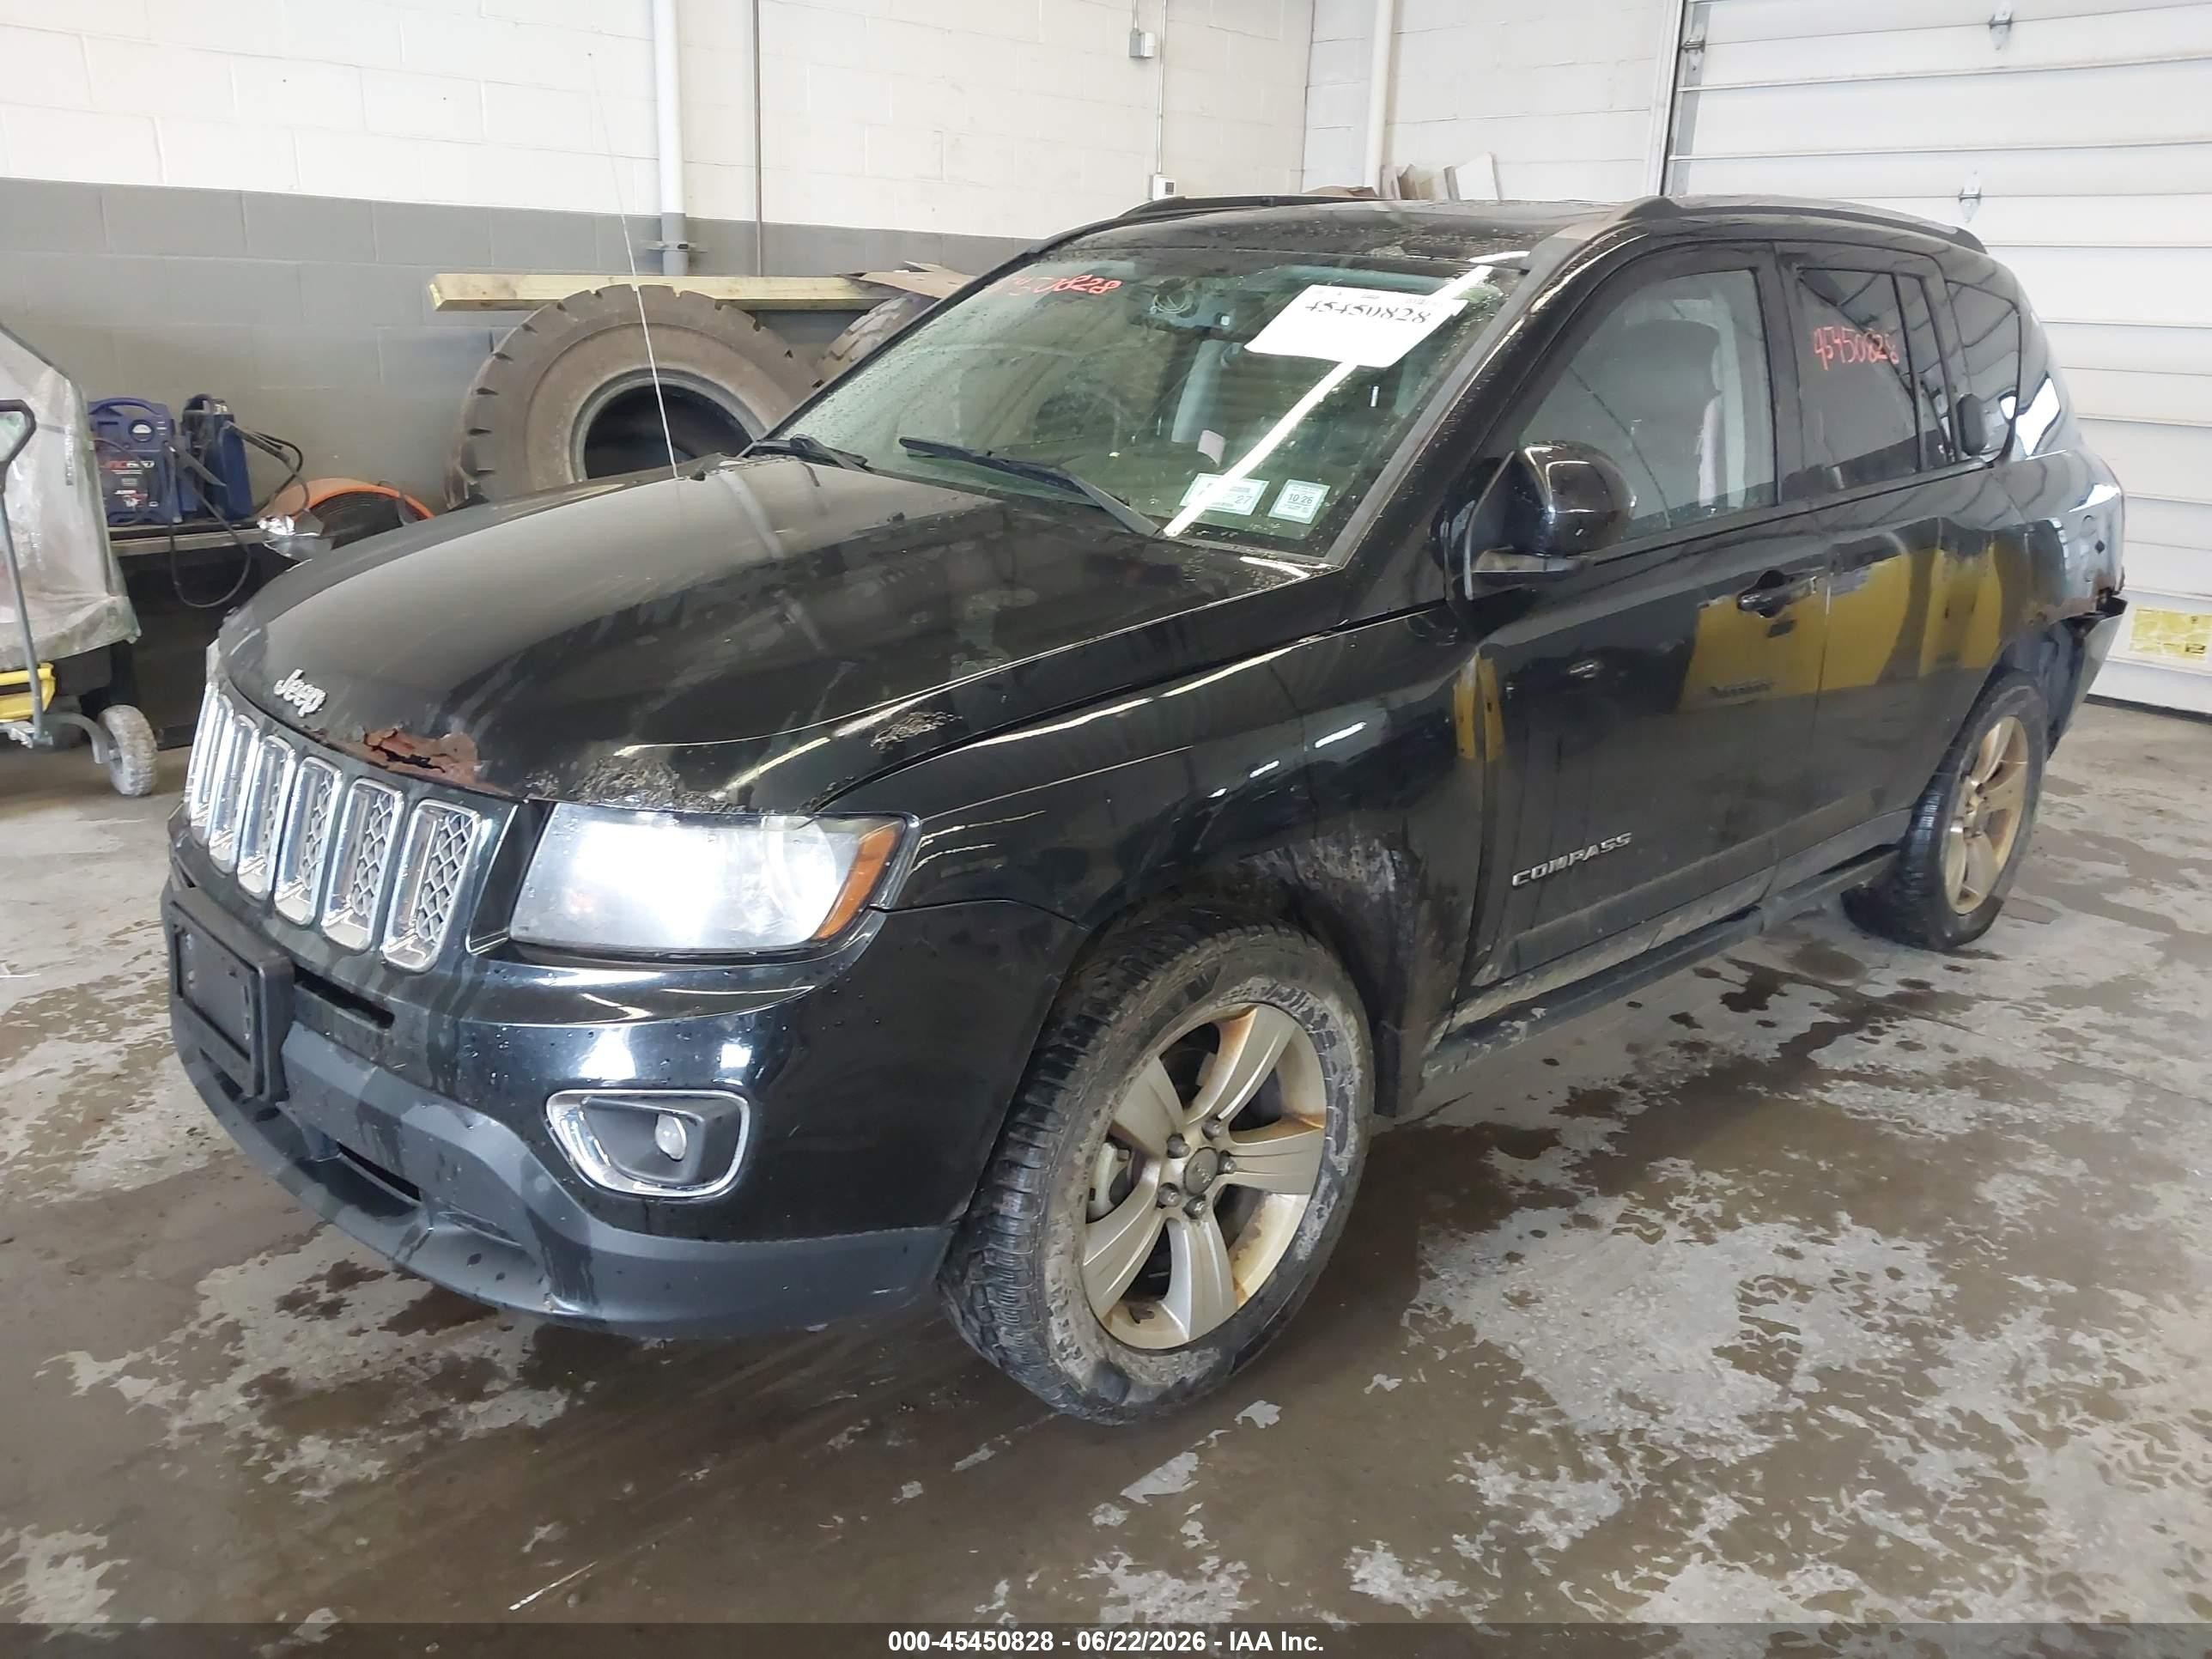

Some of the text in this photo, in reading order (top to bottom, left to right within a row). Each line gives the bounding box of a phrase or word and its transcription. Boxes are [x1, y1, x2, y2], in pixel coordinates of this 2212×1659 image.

[1305, 301, 1431, 324] 45450828
[1288, 494, 1313, 504] 10 26
[273, 669, 326, 717] Jeep
[1512, 832, 1632, 886] COMPASS
